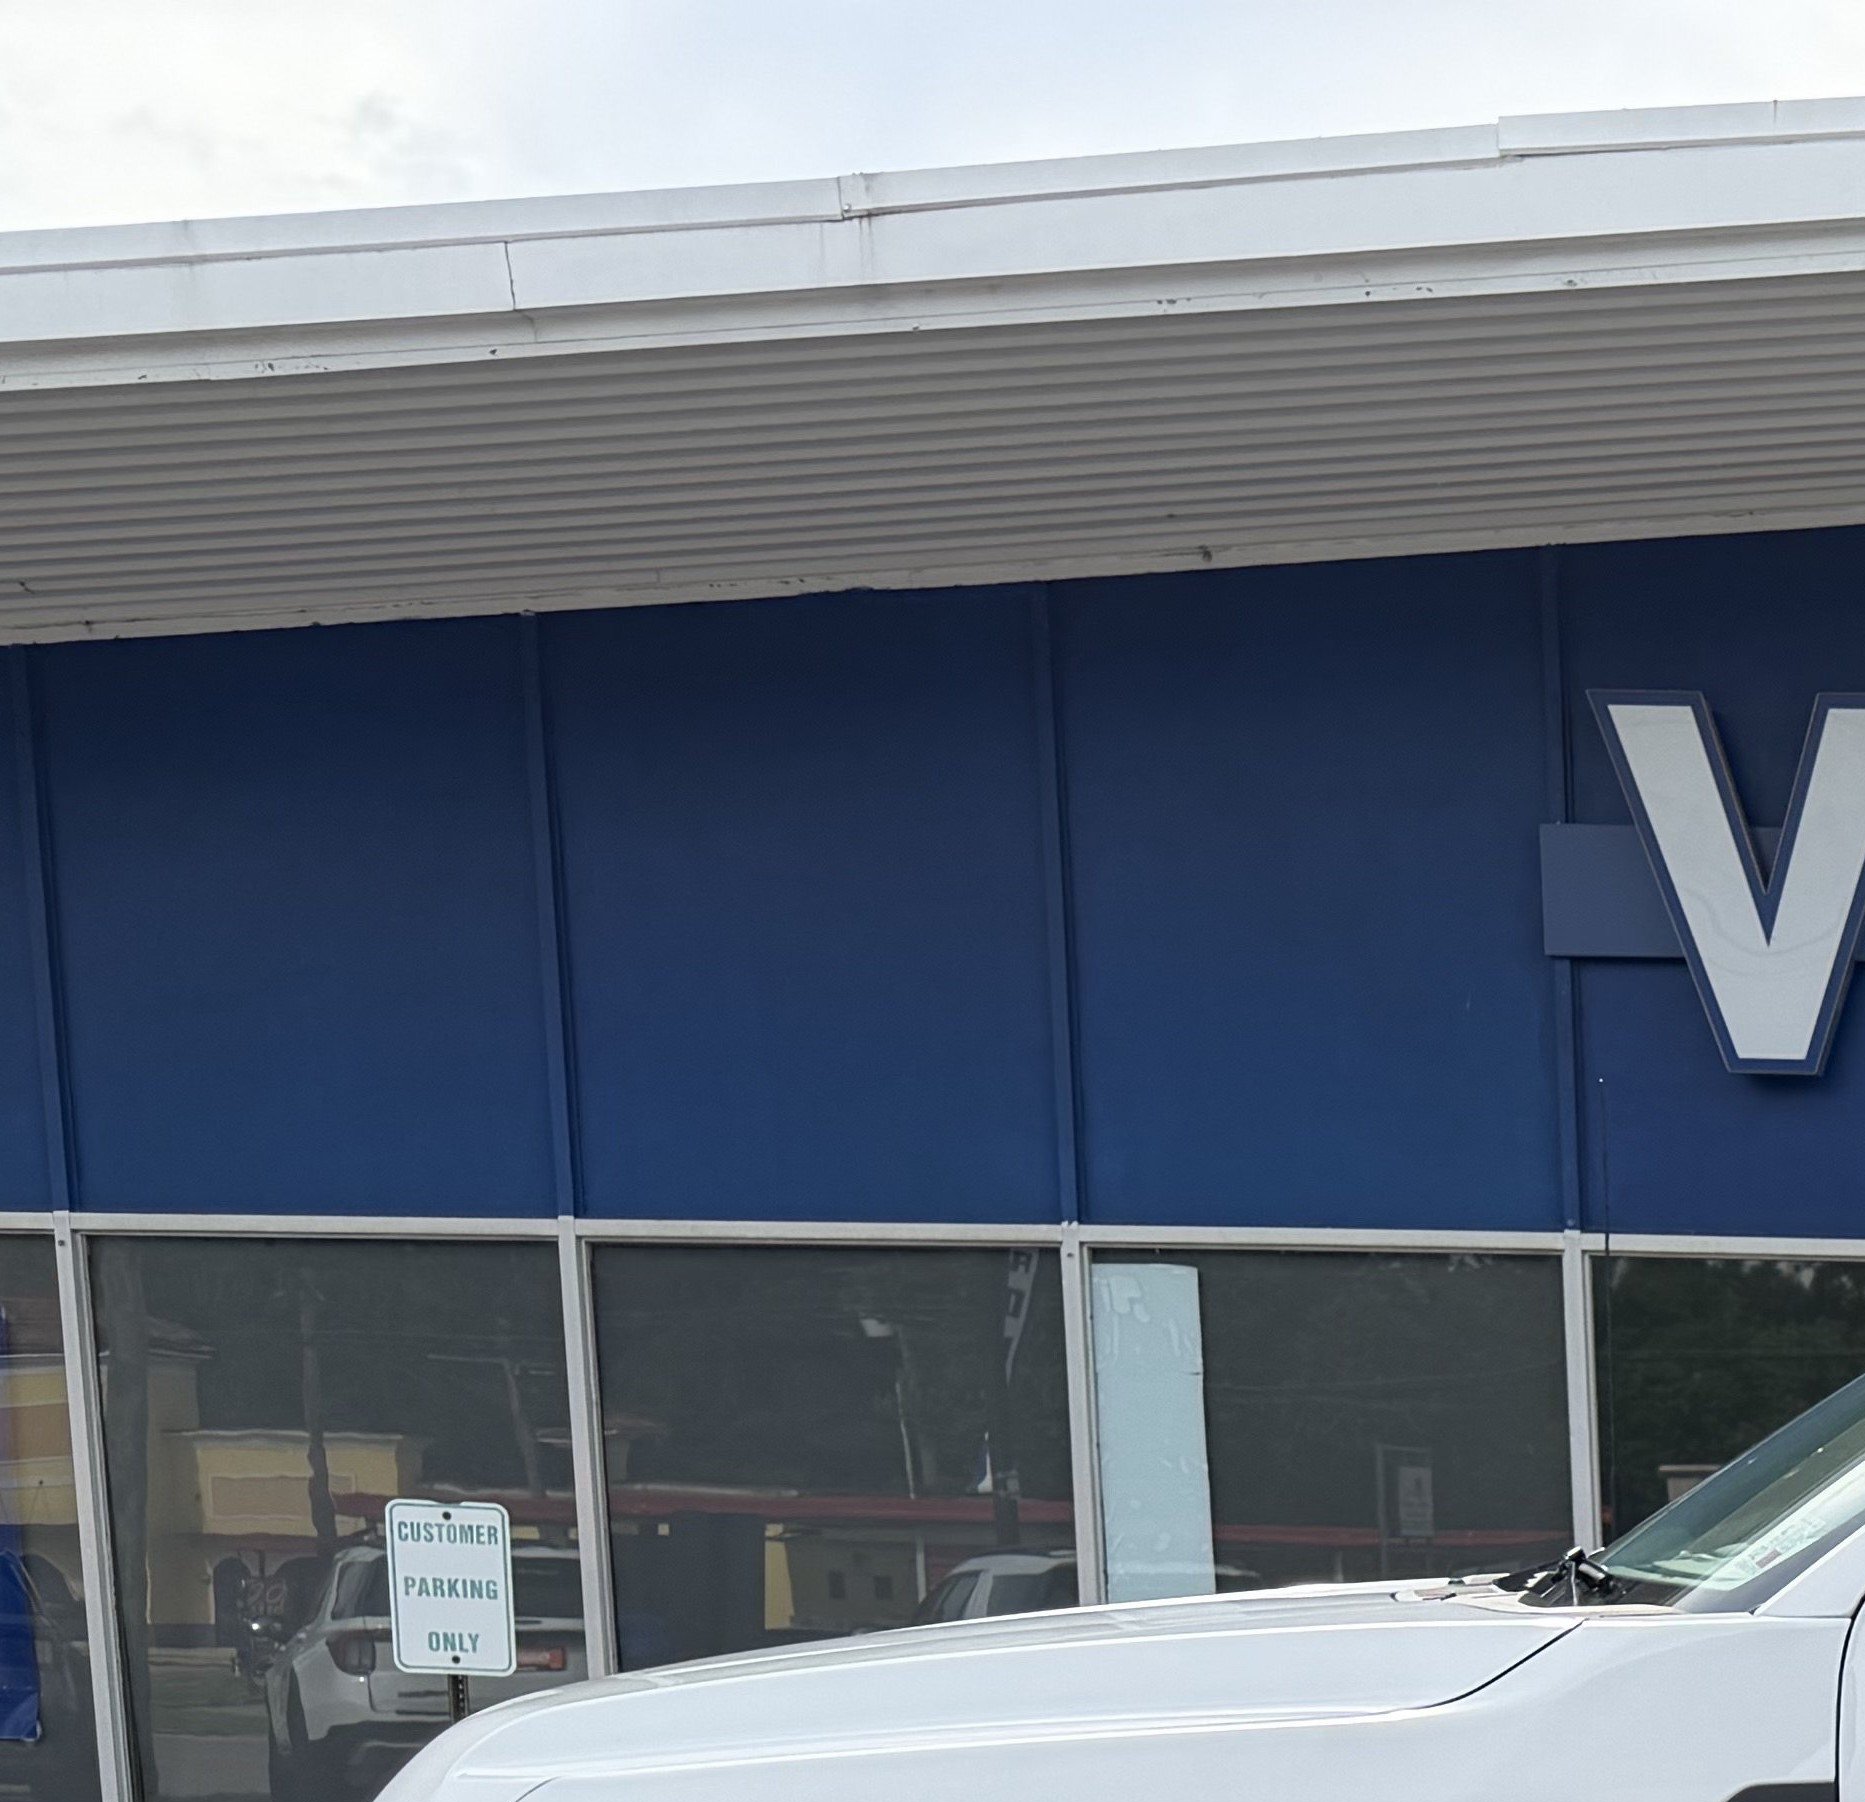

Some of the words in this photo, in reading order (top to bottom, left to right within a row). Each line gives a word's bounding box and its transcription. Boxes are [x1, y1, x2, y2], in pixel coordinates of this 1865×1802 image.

[398, 1521, 498, 1544] CUSTOMER
[404, 1576, 498, 1600] PARKING
[428, 1631, 480, 1653] ONLY
